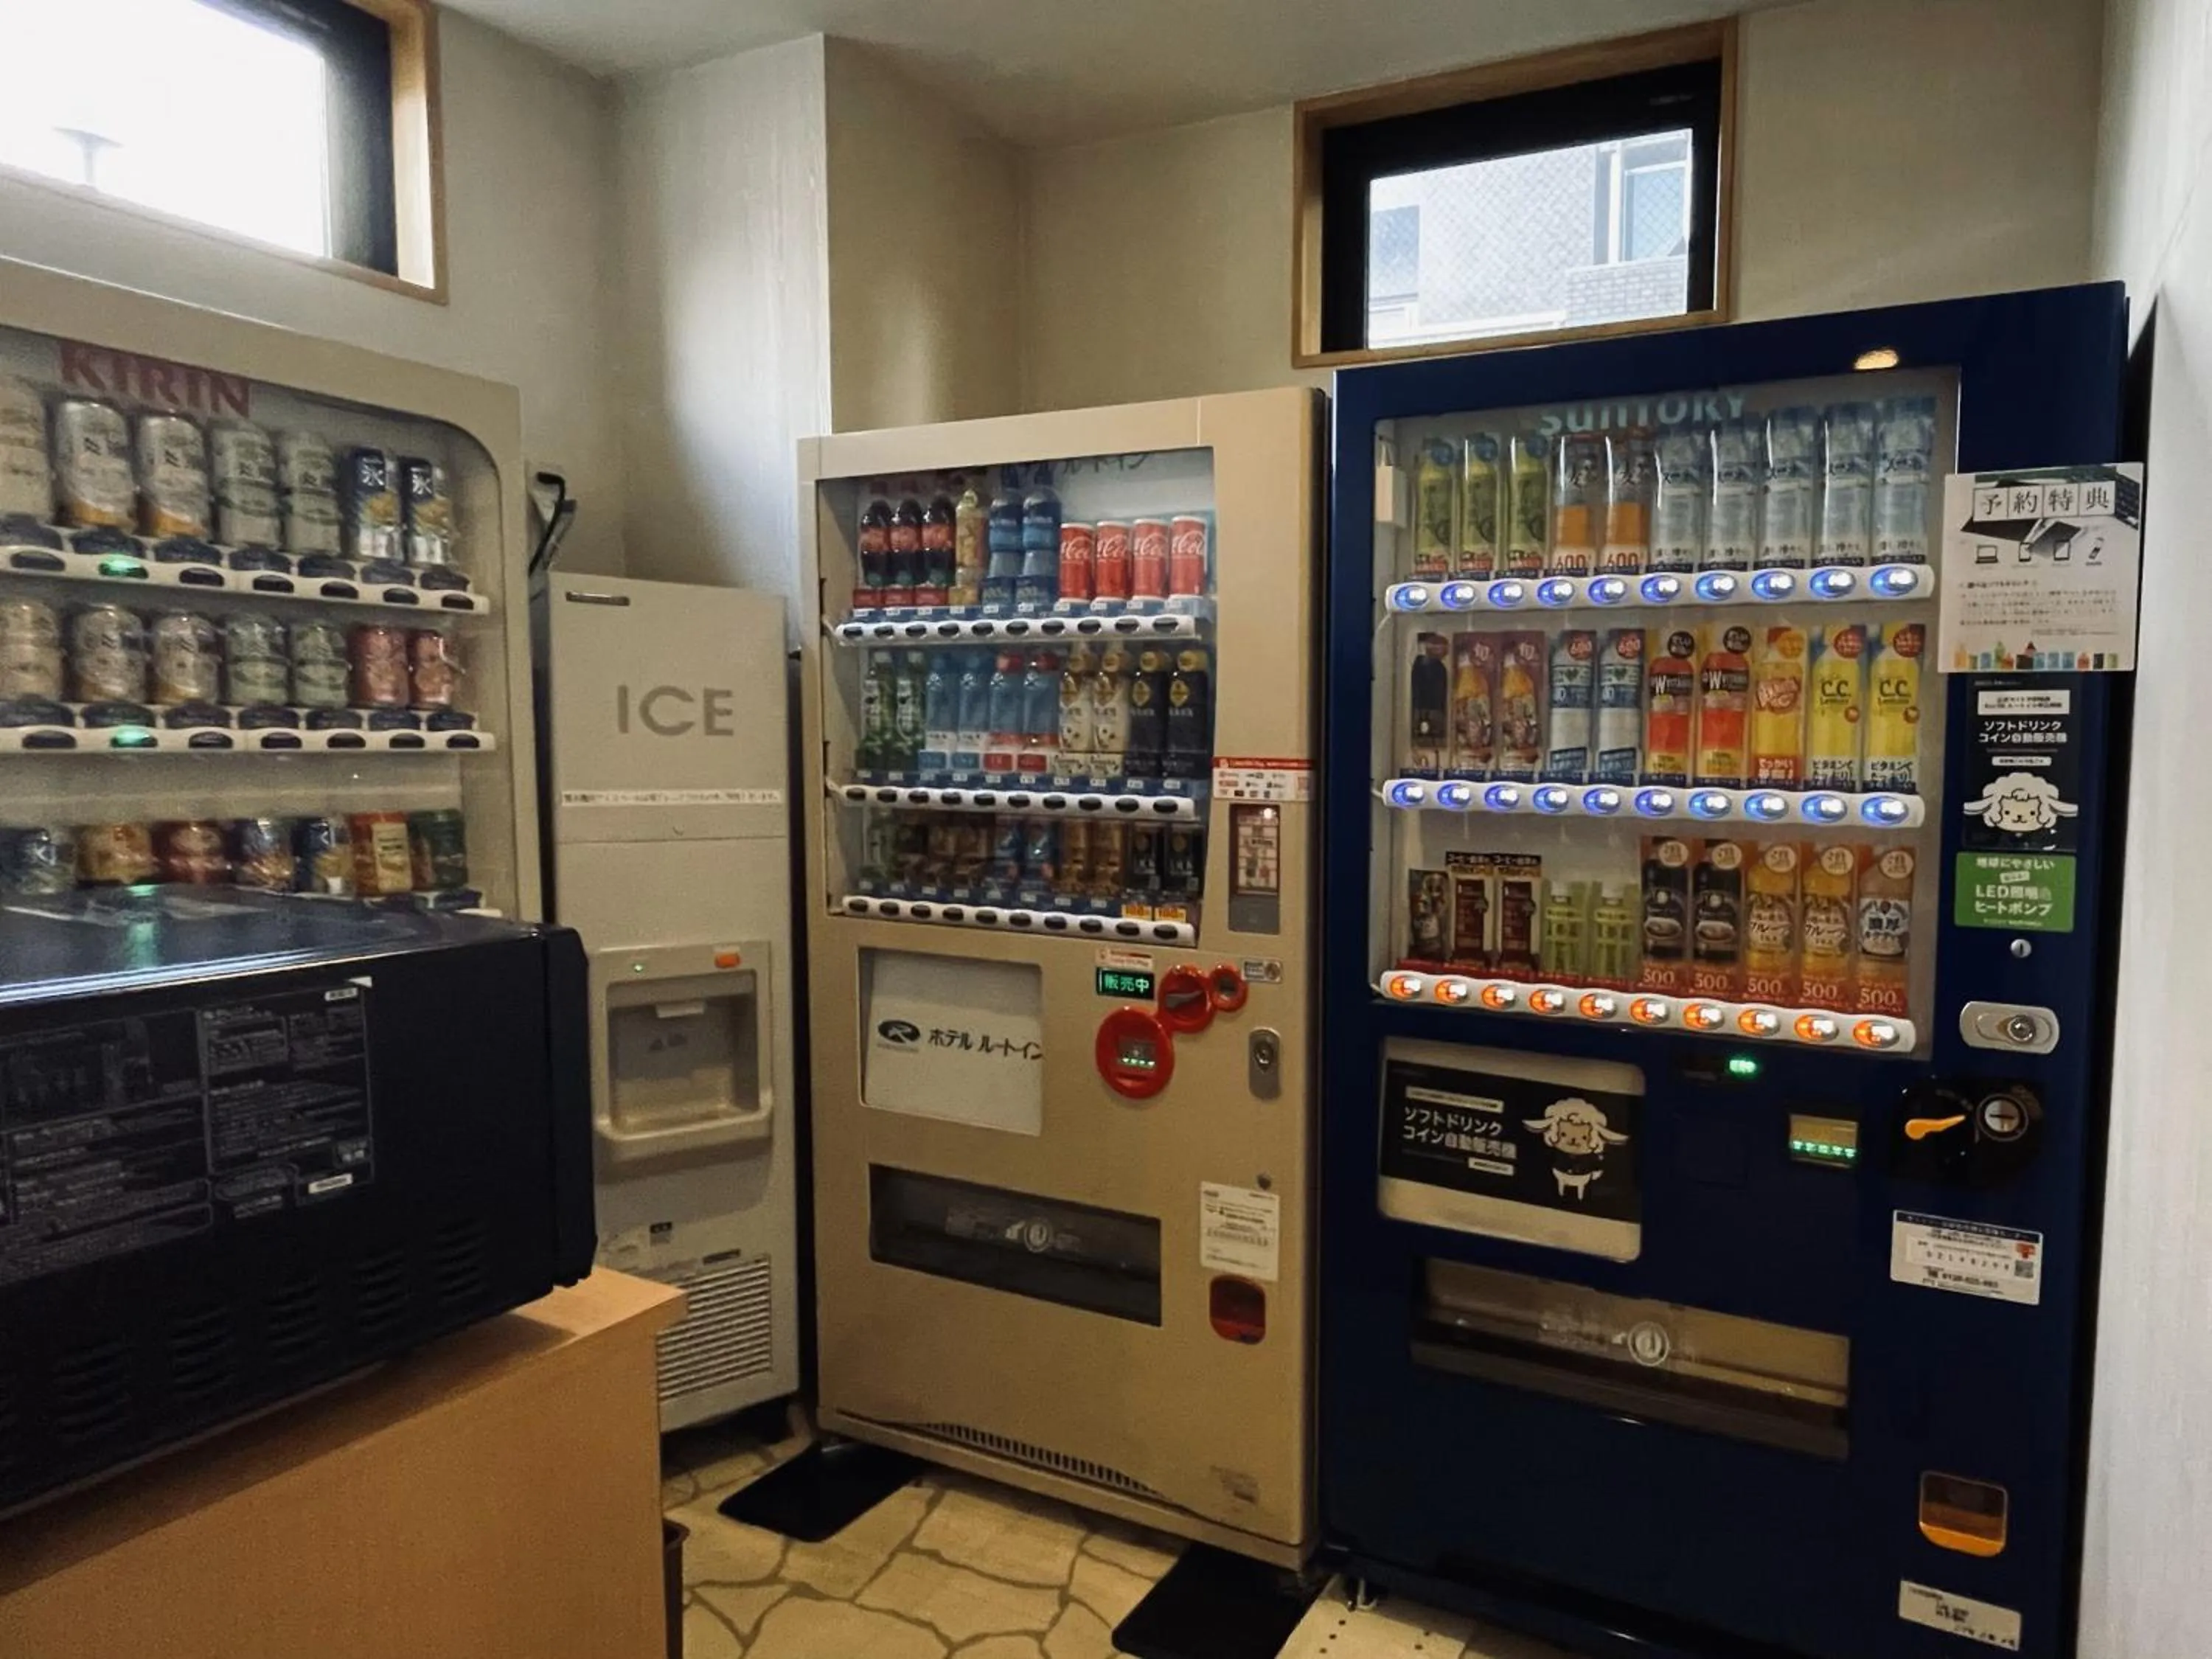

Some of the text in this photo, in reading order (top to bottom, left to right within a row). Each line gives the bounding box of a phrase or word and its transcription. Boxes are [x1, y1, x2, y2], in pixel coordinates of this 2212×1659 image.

[60, 341, 249, 419] KIRIN
[1982, 487, 2109, 515] 予約特典
[617, 684, 734, 737] ICE
[1983, 720, 2062, 731] ソフトドリンク
[1104, 974, 1150, 993] 販売中
[929, 1029, 973, 1051] ホテル
[978, 1035, 1043, 1060] ルートイン
[1405, 1107, 1503, 1136] ソフトドリンク
